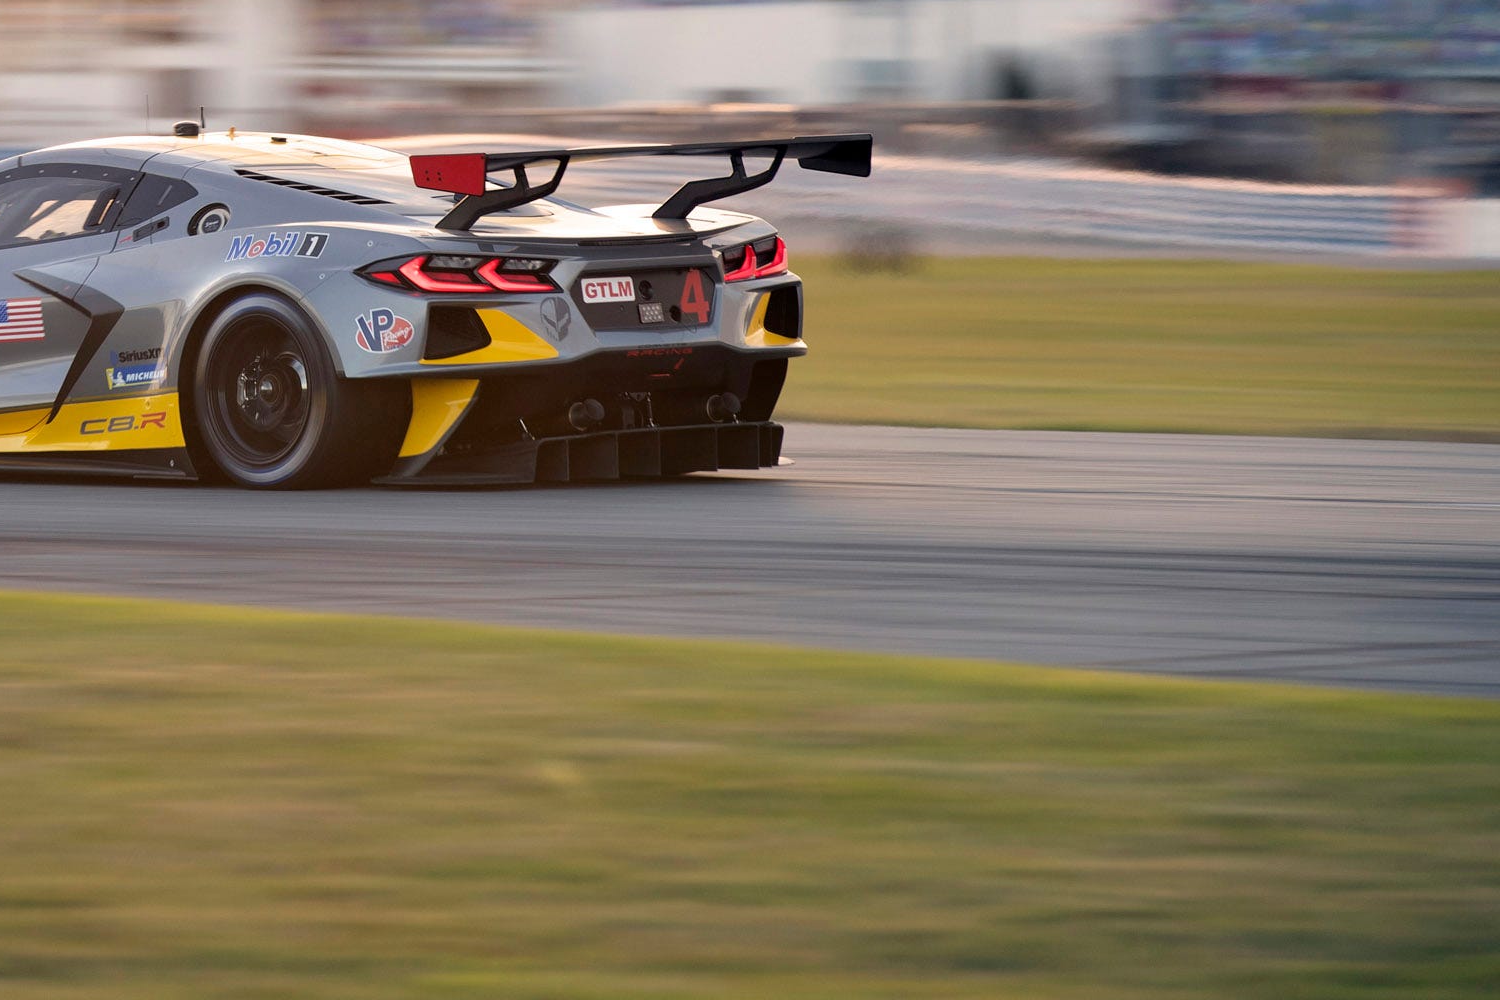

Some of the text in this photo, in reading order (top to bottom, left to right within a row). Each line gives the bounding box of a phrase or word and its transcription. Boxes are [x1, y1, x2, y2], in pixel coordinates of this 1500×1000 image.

[226, 232, 299, 261] Mobil
[584, 280, 633, 299] GTLM
[680, 268, 710, 324] 4
[356, 308, 395, 352] VP
[126, 370, 165, 382] MICHELIN
